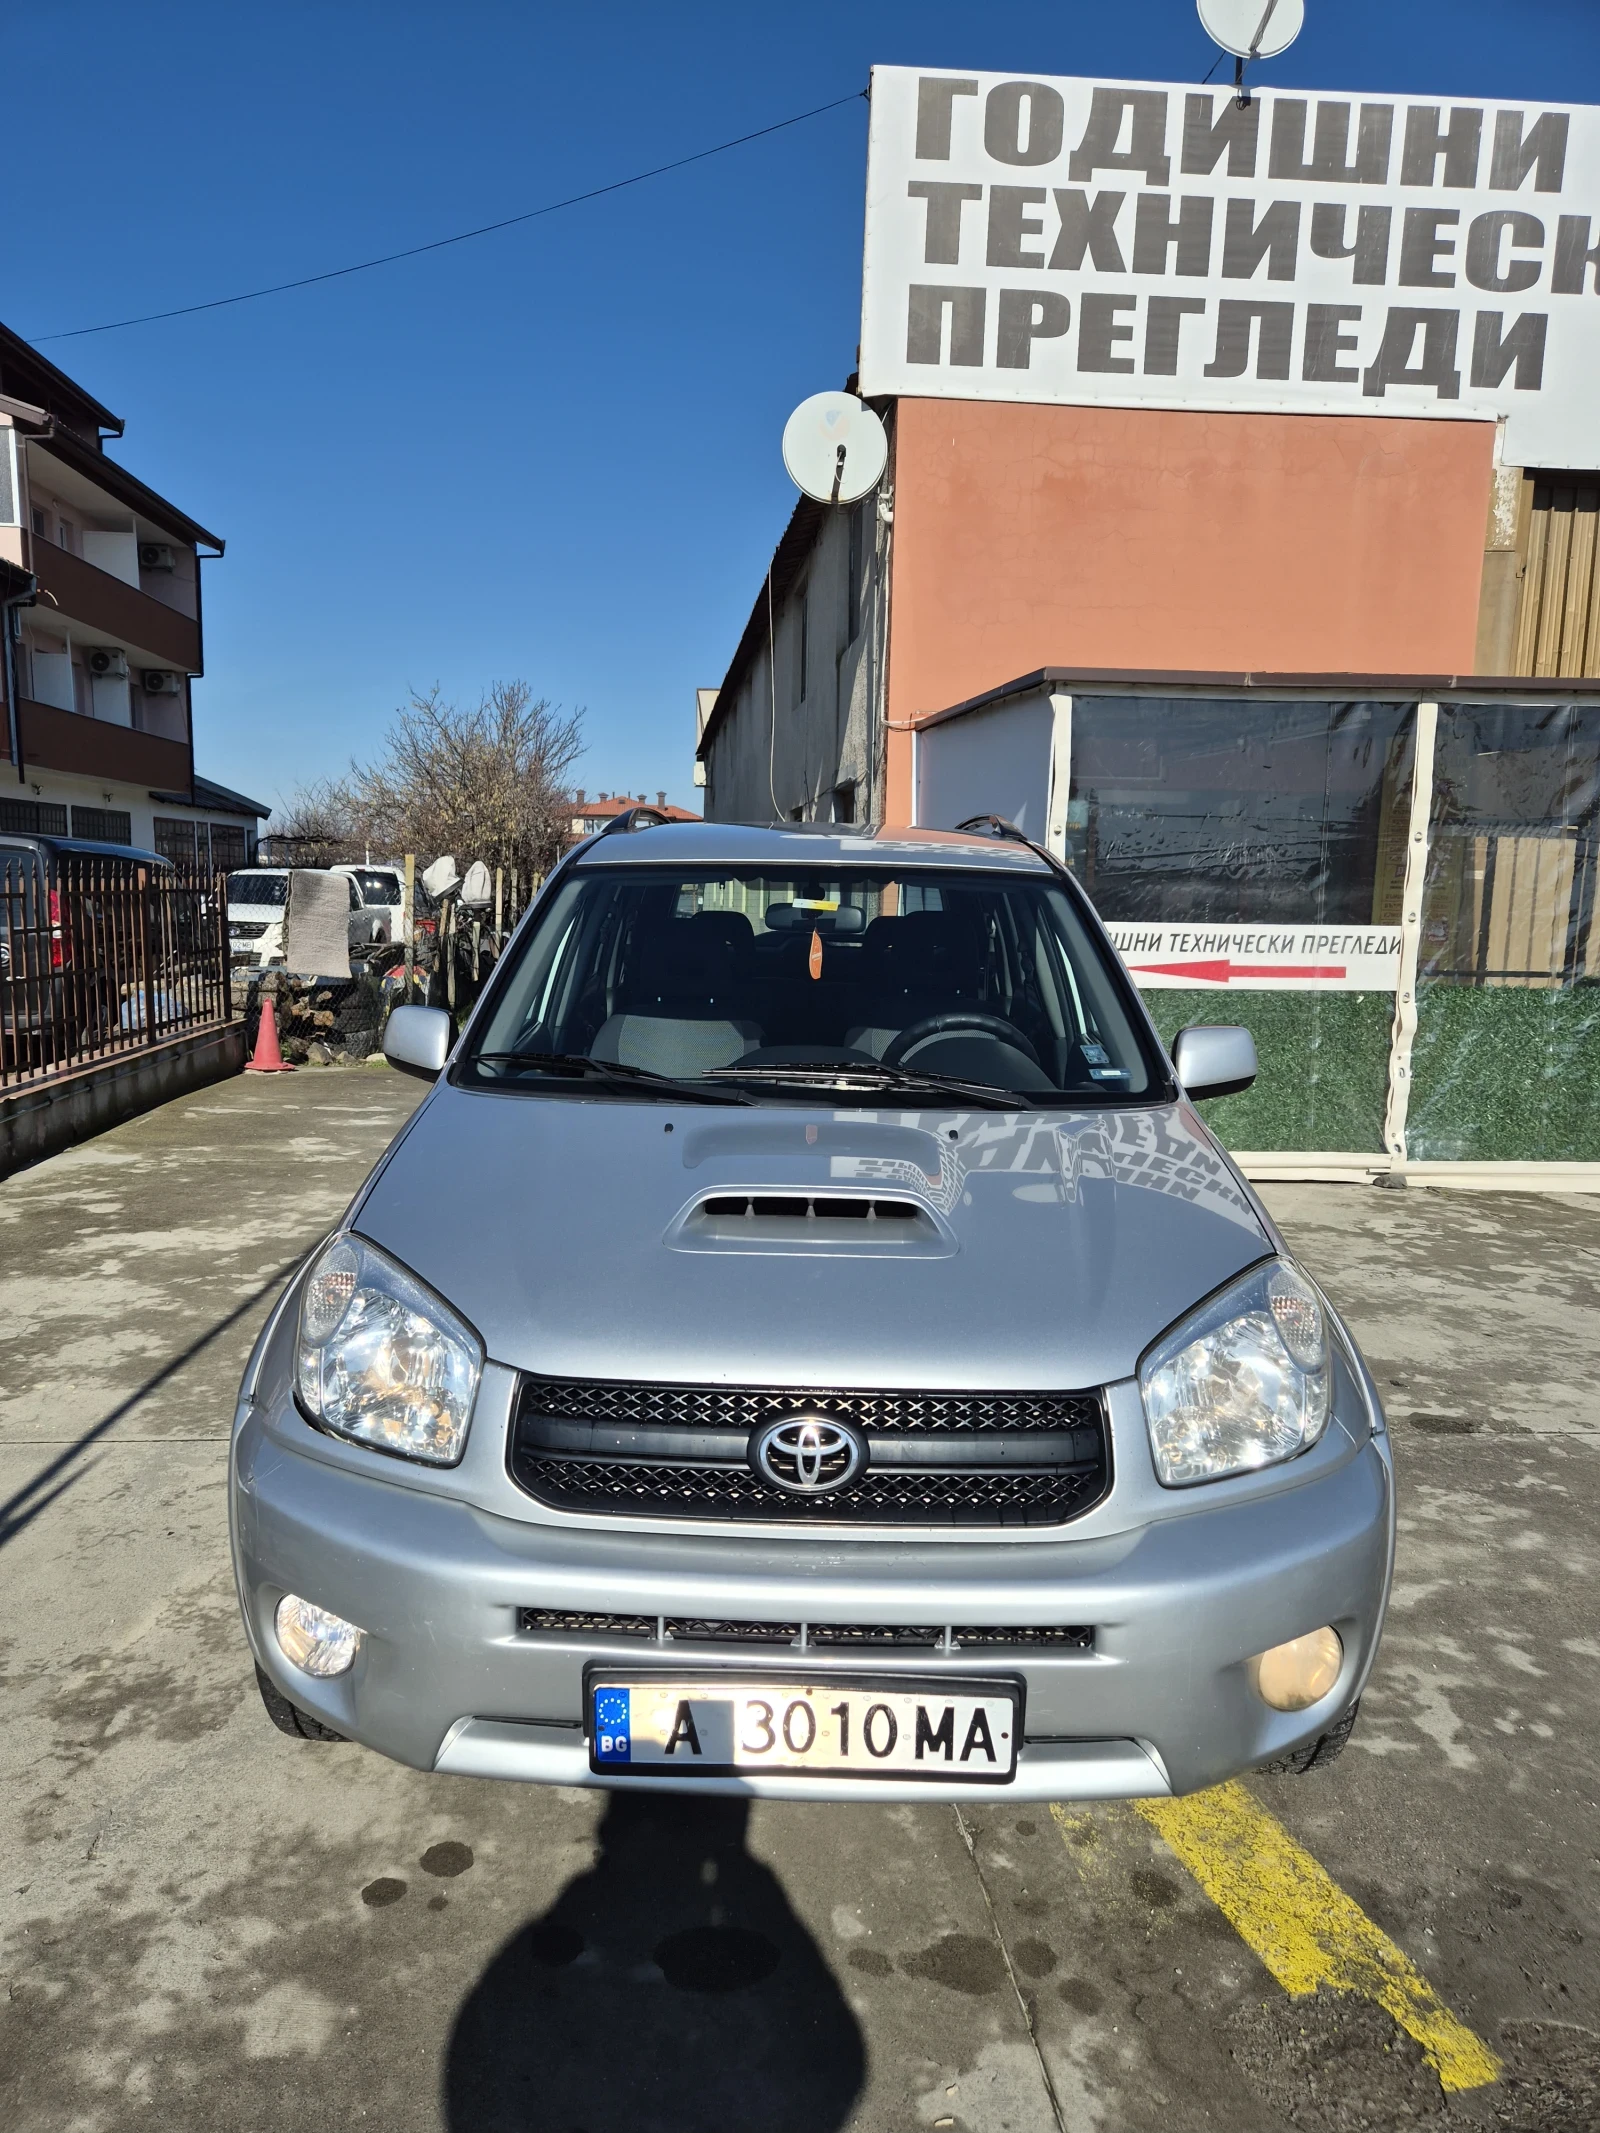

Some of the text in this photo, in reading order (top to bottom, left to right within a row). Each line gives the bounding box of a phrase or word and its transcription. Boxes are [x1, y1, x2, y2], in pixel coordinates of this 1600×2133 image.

[916, 76, 1571, 194] ГОДИШНИ
[906, 283, 1549, 400] ПРЕГЛЕДИ
[1109, 932, 1402, 955] ШНИ ТЕХНИЧЕСКИ ПРЕГЛЕДИ
[601, 1735, 627, 1753] BG
[664, 1700, 997, 1762] A 3010 MA
